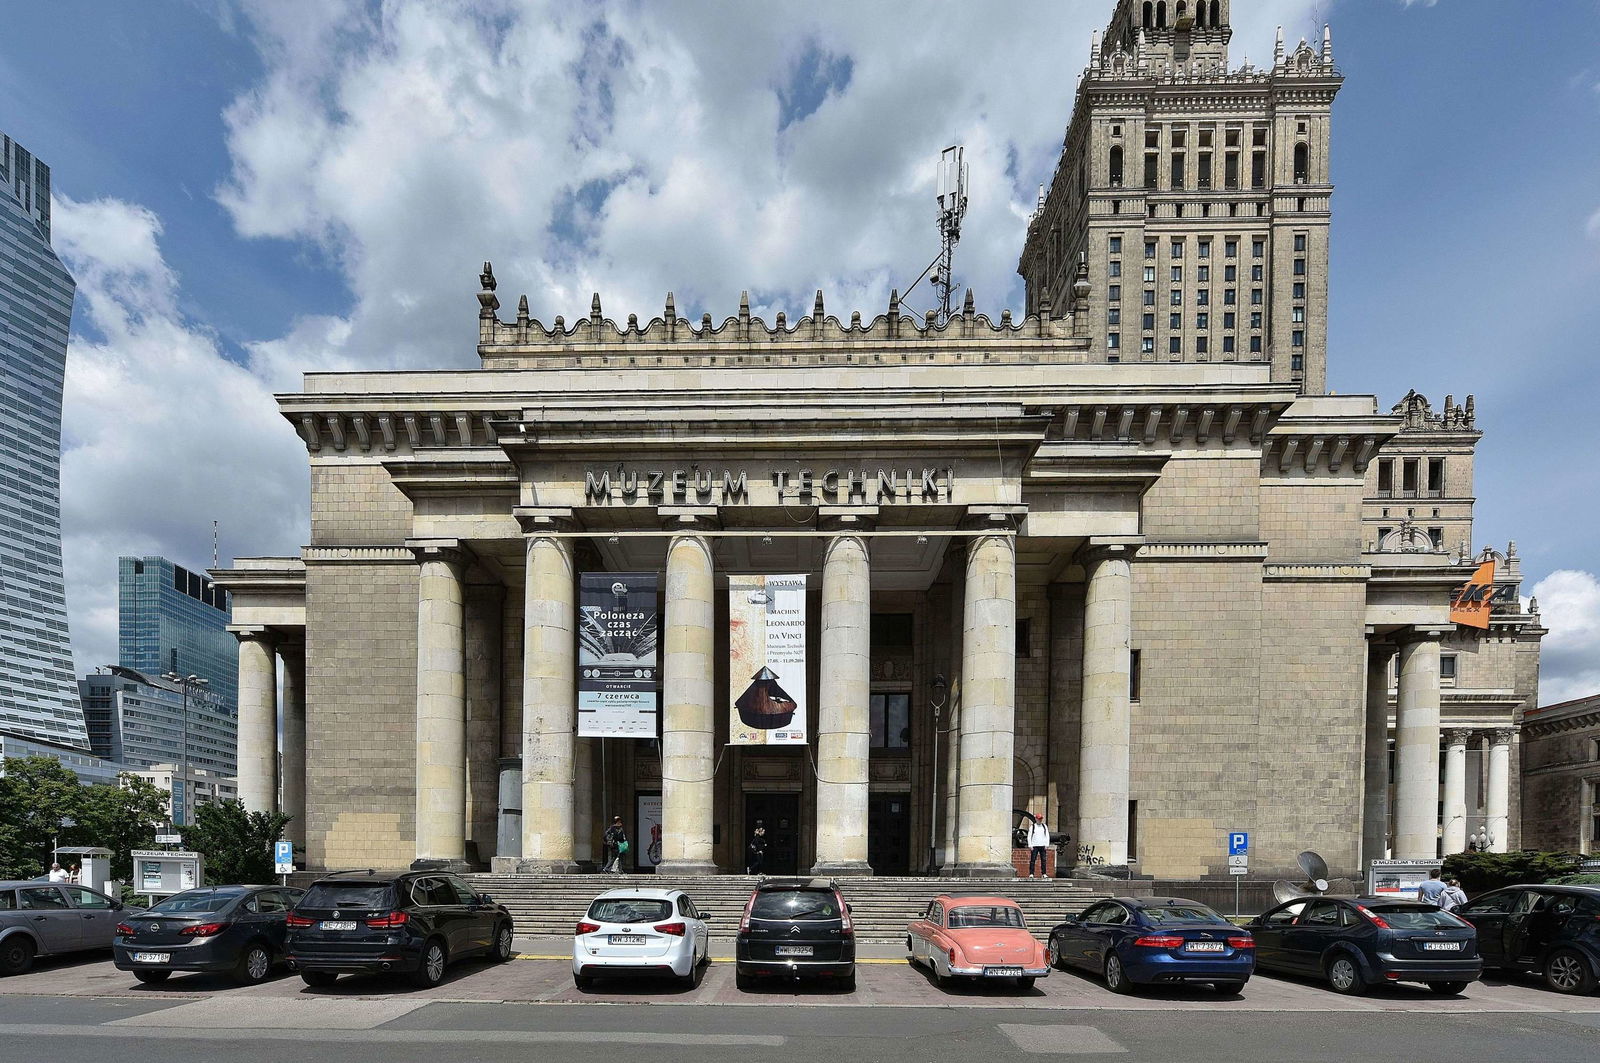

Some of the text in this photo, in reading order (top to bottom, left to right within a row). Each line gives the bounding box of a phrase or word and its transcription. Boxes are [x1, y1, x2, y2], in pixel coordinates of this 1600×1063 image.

[584, 466, 954, 498] MUZEUM TECHNIKI
[593, 610, 645, 620] Poloneza
[766, 619, 805, 627] LEONARDO
[600, 627, 638, 640] zacząć
[1233, 834, 1245, 849] P
[278, 843, 289, 858] P
